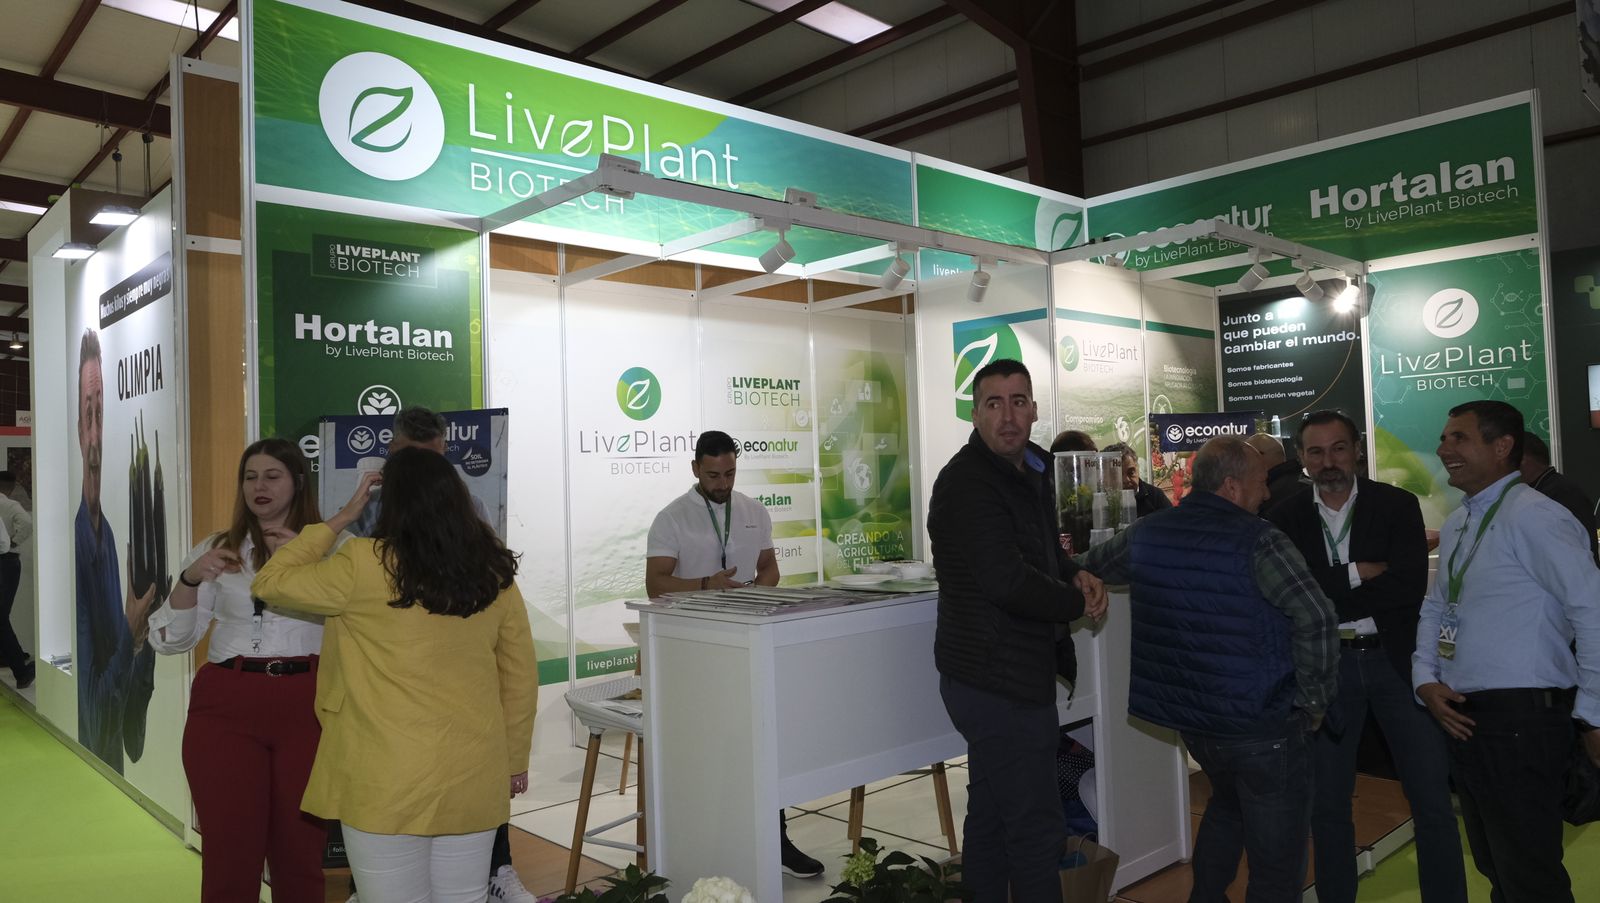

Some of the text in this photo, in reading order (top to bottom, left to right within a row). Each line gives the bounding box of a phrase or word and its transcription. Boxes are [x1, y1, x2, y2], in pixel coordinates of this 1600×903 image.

[1310, 156, 1515, 219] Hortalan
[1344, 185, 1518, 230] by LivePlant Biotech
[336, 244, 420, 263] LIVEPLANT
[1135, 255, 1150, 268] by
[1154, 242, 1214, 263] LivePlant
[337, 256, 420, 278] BIOTECH
[1223, 313, 1260, 326] Junto
[1265, 312, 1274, 321] a
[295, 313, 453, 349] Hortalan
[1224, 322, 1306, 341] que pueden
[1224, 331, 1360, 354] cambiar el mundo.
[325, 344, 454, 362] by LivePlant Biotech
[1381, 339, 1532, 374] LivePlant
[117, 343, 163, 401] OLIMPIA
[1227, 361, 1294, 374] Somos fabricantes
[732, 376, 800, 390] LIVEPLANT
[1228, 380, 1252, 388] Somos
[1417, 374, 1493, 391] BIOTECH
[734, 391, 800, 407] BIOTECH
[1228, 389, 1315, 402] Somos nutrición vegetal
[1185, 422, 1248, 437] econatur
[579, 430, 697, 453] LivePlant
[743, 438, 798, 452] econatur
[611, 461, 670, 475] BIOTECH
[837, 531, 890, 545] CREANDO
[838, 543, 905, 558] AGRICULTURA
